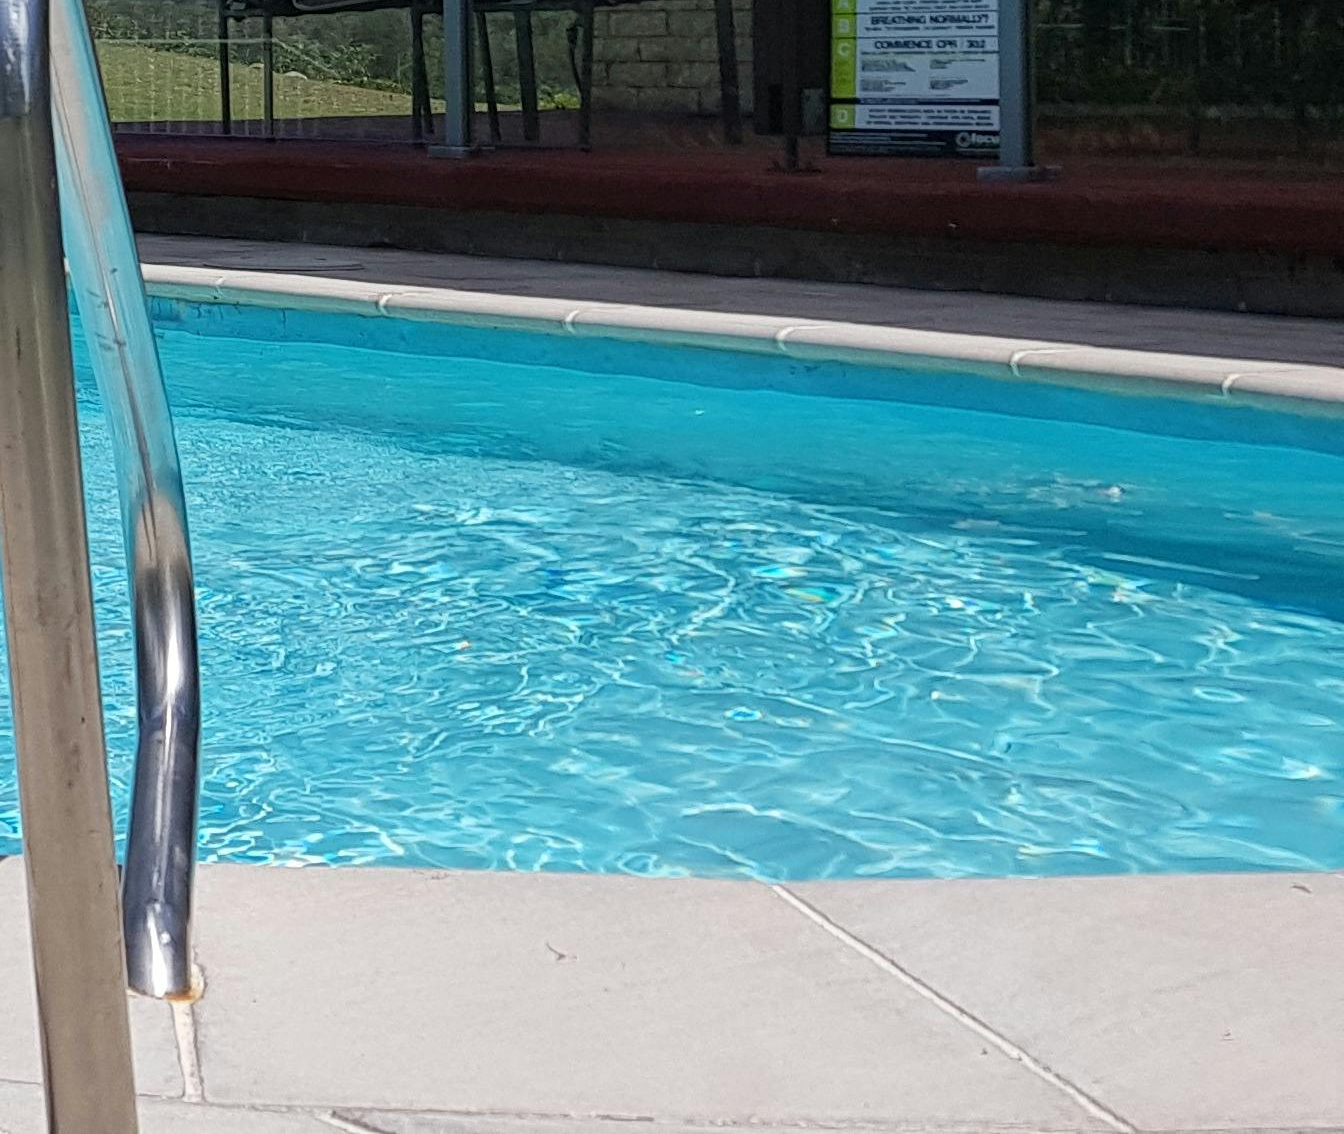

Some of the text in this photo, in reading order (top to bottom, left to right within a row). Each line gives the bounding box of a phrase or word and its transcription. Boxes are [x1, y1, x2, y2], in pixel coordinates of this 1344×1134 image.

[870, 15, 927, 25] BREATHING
[874, 39, 933, 49] COMMENCE
[936, 39, 958, 49] CPR
